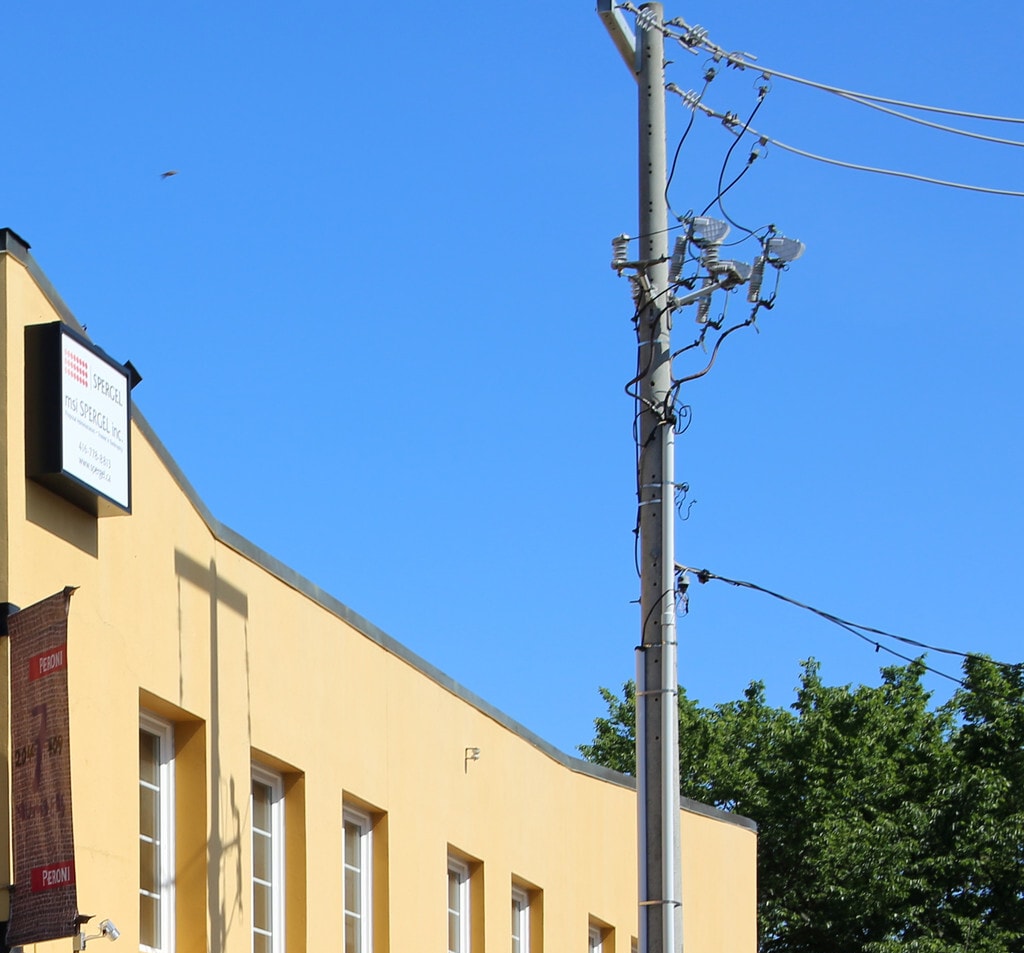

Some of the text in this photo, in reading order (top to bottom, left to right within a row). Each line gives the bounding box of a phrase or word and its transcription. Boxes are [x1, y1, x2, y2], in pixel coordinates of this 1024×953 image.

[92, 373, 123, 407] SPERGEL
[65, 394, 79, 413] msi
[79, 400, 110, 434] SPERGEL
[39, 650, 63, 674] PERONI
[42, 866, 70, 887] PERONI
